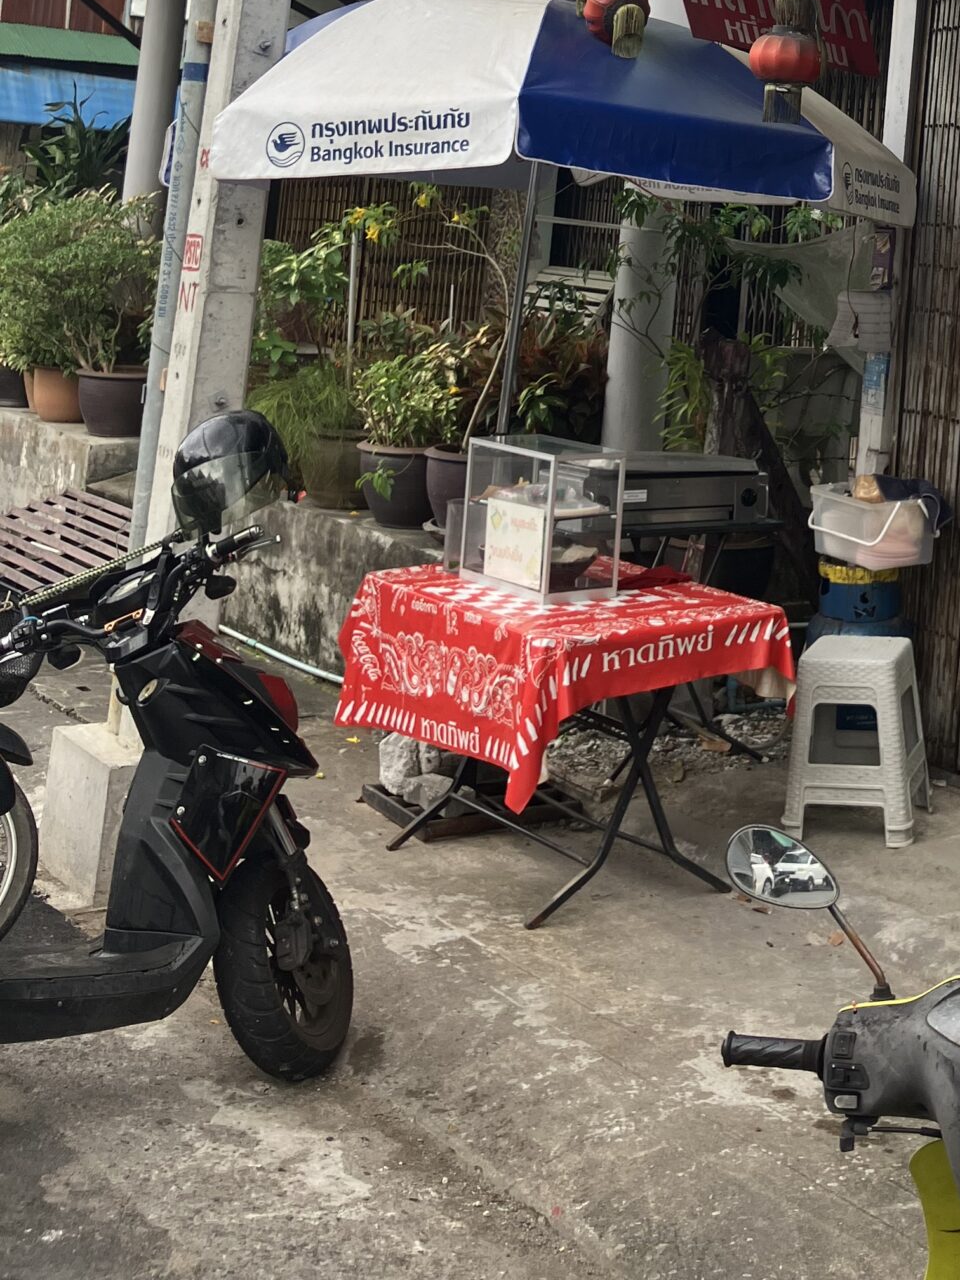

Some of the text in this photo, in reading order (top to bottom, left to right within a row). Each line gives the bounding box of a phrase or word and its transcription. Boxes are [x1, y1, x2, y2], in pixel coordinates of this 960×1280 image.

[311, 107, 470, 144] กรุงเทพประกันภัย
[310, 138, 469, 164] Bangkok Insurance
[178, 281, 200, 313] NT
[602, 625, 713, 673] หาดทิพย์
[420, 716, 480, 754] หาดทิพย์
